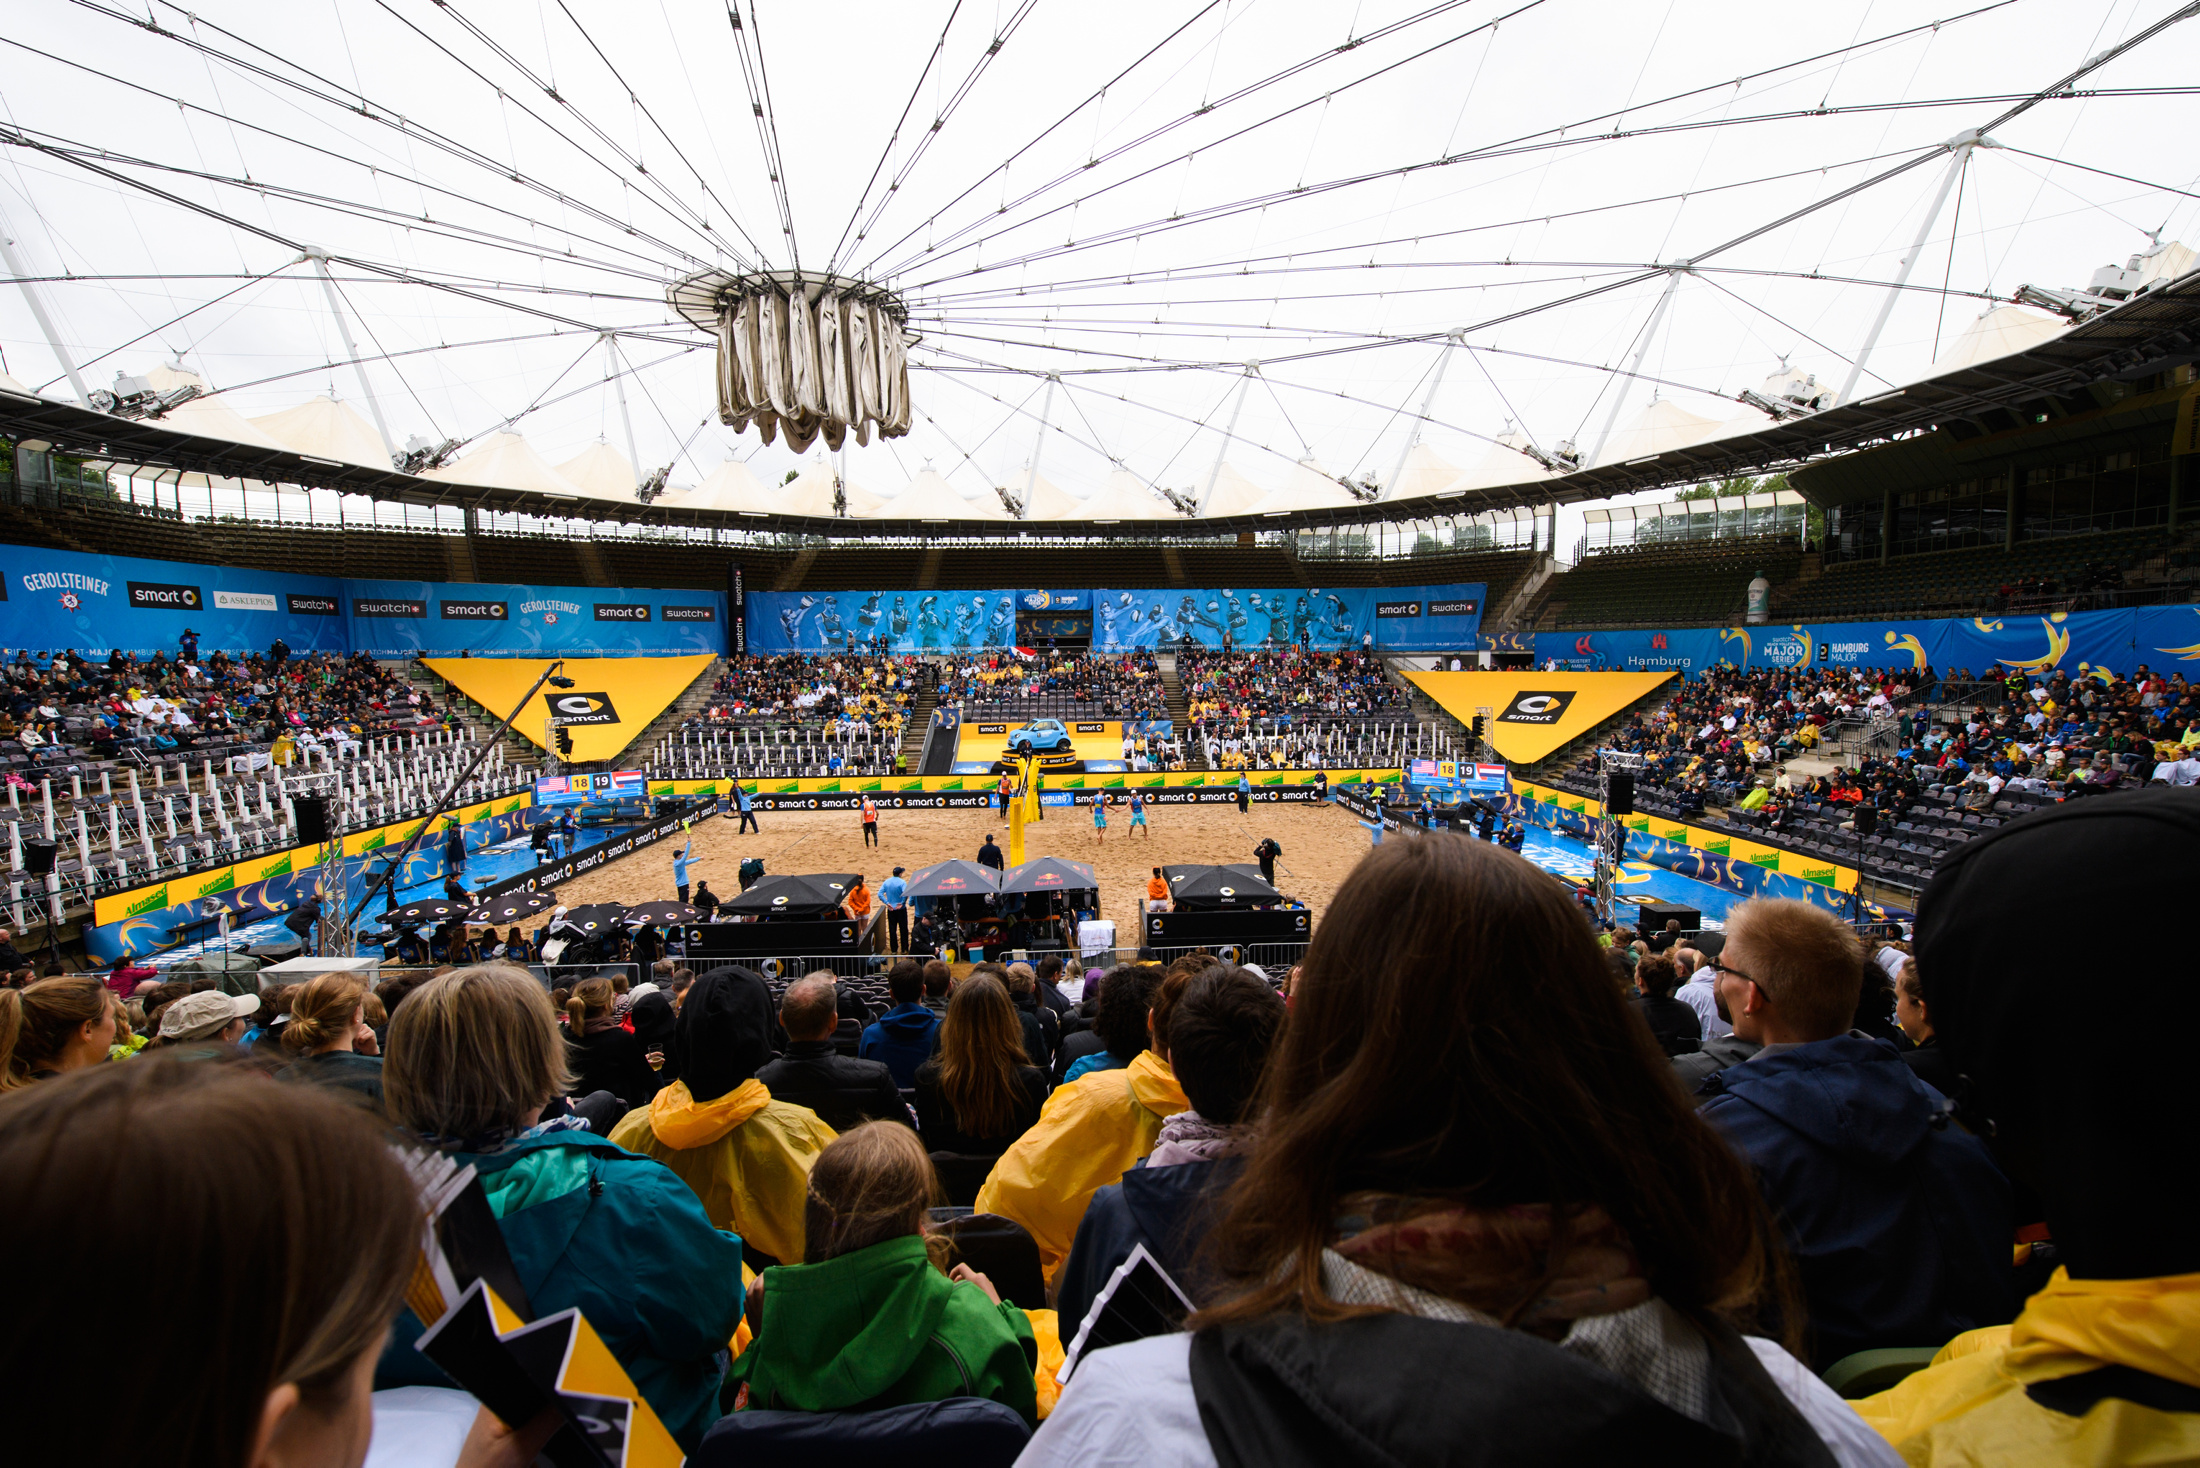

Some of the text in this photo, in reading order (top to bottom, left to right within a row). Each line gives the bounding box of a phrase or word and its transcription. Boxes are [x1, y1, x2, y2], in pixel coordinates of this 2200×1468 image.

[23, 572, 108, 596] GEROLSTEINER
[135, 589, 180, 603] smart
[230, 597, 273, 606] ASKLEPIOS
[292, 600, 328, 610] swatch
[360, 604, 410, 612] swatch
[447, 605, 486, 615] smart
[520, 600, 580, 614] GEROLSTEINER
[1380, 606, 1406, 614] smart
[1432, 603, 1466, 612] swatch
[599, 608, 632, 617] smart
[666, 610, 704, 618] swatch
[1764, 646, 1802, 656] MAJOR
[1832, 643, 1869, 652] HAMBURG
[1628, 656, 1691, 668] Hamburg
[1832, 653, 1857, 662] MAJOR
[563, 714, 610, 722] smart
[1442, 766, 1454, 774] 18
[1460, 766, 1473, 775] 19
[574, 778, 588, 788] 18
[595, 776, 608, 786] 19
[1159, 794, 1185, 802] smart
[1200, 793, 1226, 801] smart
[1248, 792, 1267, 800] mart
[1282, 791, 1308, 800] smart
[779, 800, 805, 808] smart
[822, 799, 848, 808] smart
[907, 798, 933, 806] smart
[950, 797, 976, 806] smart
[1350, 800, 1361, 812] smart
[1570, 799, 1585, 810] Almased
[701, 808, 714, 818] smart
[1383, 817, 1395, 828] smart
[1629, 816, 1649, 828] Almased
[660, 824, 674, 835] smart
[1664, 826, 1687, 838] Almased
[361, 828, 385, 851] Almased
[635, 834, 651, 846] smart
[1704, 837, 1731, 850] Almased
[608, 846, 626, 858] smart
[1750, 850, 1780, 862] Almased
[260, 852, 291, 880] Almased
[576, 859, 597, 872] smart
[1801, 866, 1837, 878] Almased
[198, 866, 235, 897] Almased
[540, 870, 564, 886] smart
[500, 884, 525, 896] mart
[125, 883, 168, 918] Almased
